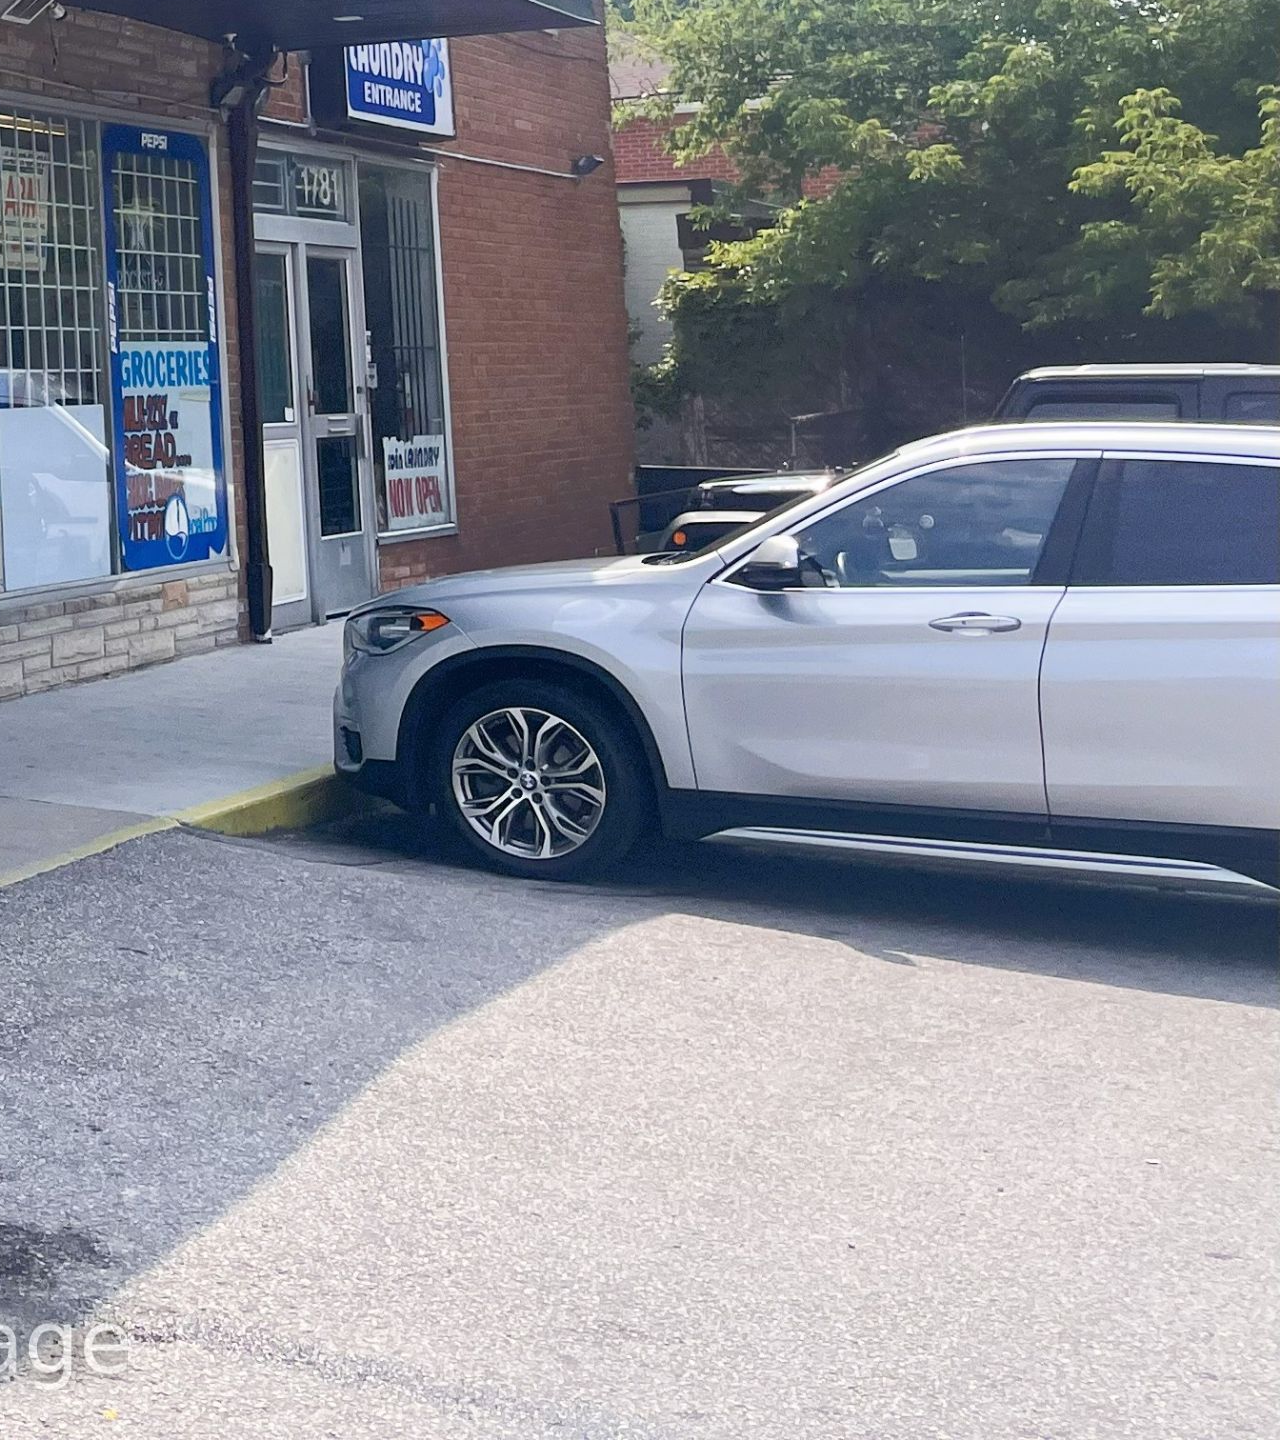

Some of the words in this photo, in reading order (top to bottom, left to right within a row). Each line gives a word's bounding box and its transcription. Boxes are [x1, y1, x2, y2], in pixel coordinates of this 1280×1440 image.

[364, 81, 422, 113] ENTRANCE
[141, 132, 167, 150] PEPSI
[301, 167, 338, 206] 1781
[121, 349, 210, 388] GROCERIES
[389, 478, 414, 518] NOW
[415, 475, 443, 515] OPEN
